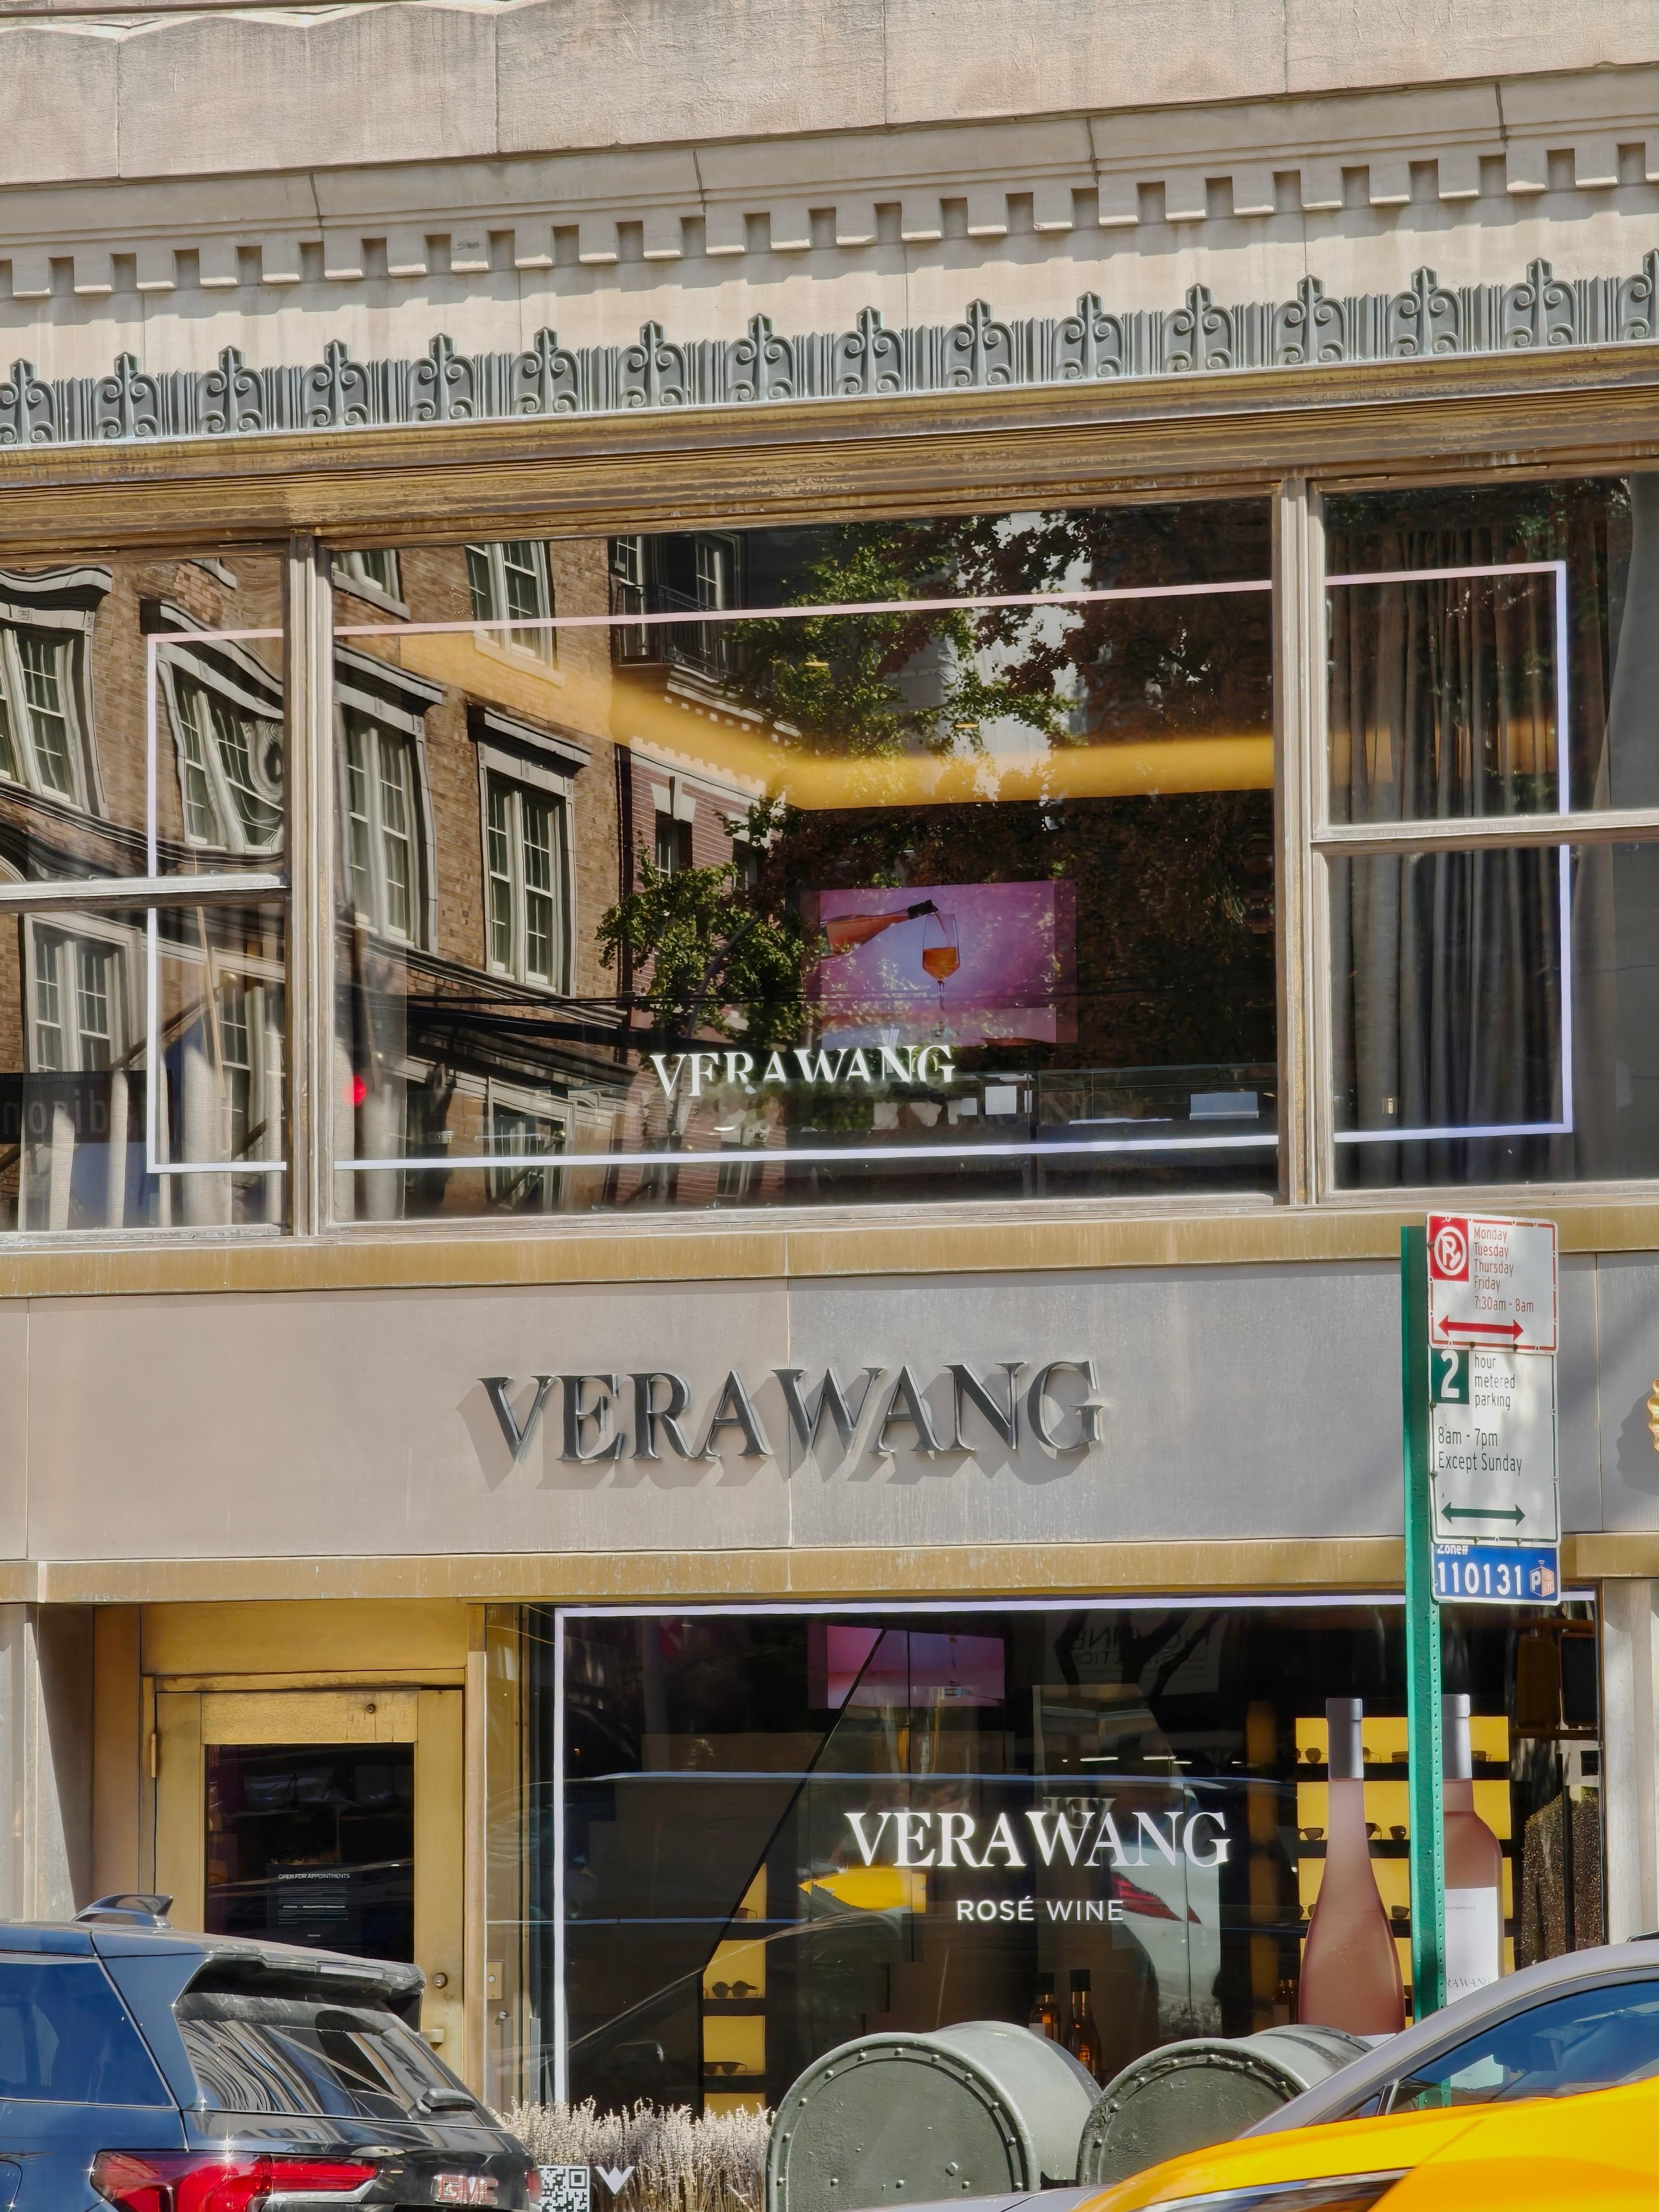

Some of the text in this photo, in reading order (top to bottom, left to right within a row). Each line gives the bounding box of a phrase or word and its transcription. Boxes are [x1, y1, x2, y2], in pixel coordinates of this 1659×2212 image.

[1474, 1226, 1507, 1243] Monday
[1474, 1242, 1509, 1258] Tuesday
[1474, 1259, 1514, 1275] Thursday
[1474, 1276, 1500, 1292] Friday
[1474, 1296, 1506, 1311] 7:30am
[1515, 1298, 1534, 1313] 8am
[1474, 1354, 1496, 1369] hour
[1440, 1351, 1460, 1399] 2
[1474, 1374, 1515, 1390] metered
[1475, 1393, 1510, 1411] parking
[1438, 1426, 1462, 1445] 8am
[1474, 1428, 1498, 1450] 7pm
[1438, 1451, 1522, 1476] Except Sunday
[1438, 1562, 1521, 1595] 110131
[956, 1896, 1124, 1921] ROSÉ WINE
